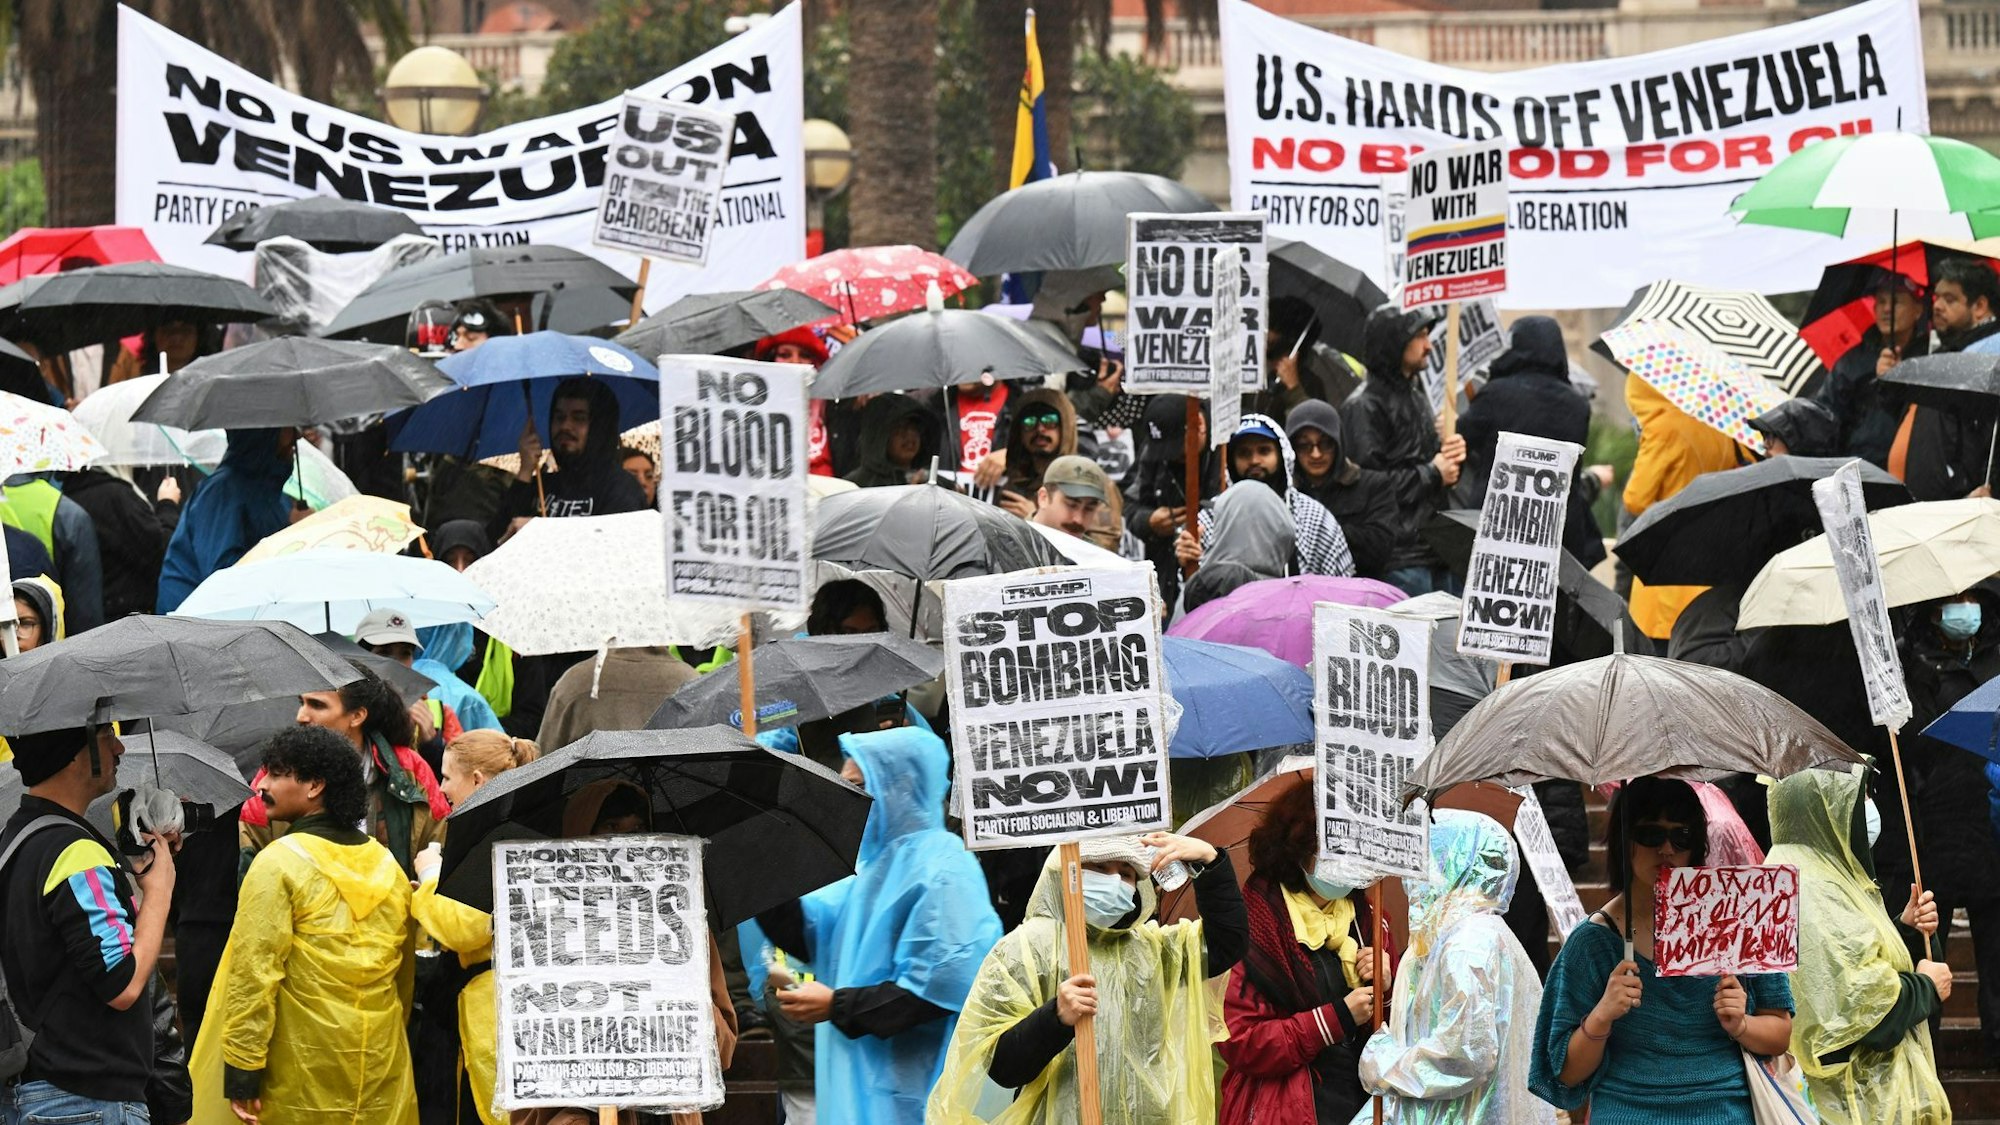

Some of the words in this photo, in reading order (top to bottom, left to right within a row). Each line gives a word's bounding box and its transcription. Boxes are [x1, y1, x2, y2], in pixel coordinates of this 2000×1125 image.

[1256, 54, 1336, 125] U.S.
[1346, 77, 1504, 141] HANDS
[1515, 90, 1601, 148] OFF
[1611, 34, 1888, 144] VENEZUELA
[166, 63, 275, 123] NO
[292, 112, 402, 164] US
[624, 105, 723, 155] US
[163, 111, 777, 211] VENEZUA
[616, 145, 718, 182] OUT
[1253, 137, 1346, 172] NO
[1359, 142, 1610, 180] BOD
[1625, 135, 1774, 177] FOR
[1411, 160, 1437, 199] NO
[1448, 149, 1502, 191] WAR
[154, 194, 219, 225] PARTY
[610, 173, 629, 197] OF
[682, 188, 712, 214] THE
[1309, 195, 1348, 227] FOR
[1432, 192, 1477, 221] WITH
[603, 199, 708, 242] CARIBBEAN
[1136, 246, 1185, 297] NO
[1406, 242, 1504, 283] VENEZUELA!
[1185, 327, 1207, 335] ON
[697, 369, 768, 406] NO
[674, 406, 793, 480] BLOOD
[1491, 461, 1570, 499] STOP
[672, 490, 739, 556] FOR
[747, 494, 799, 562] OIL
[956, 596, 1146, 647] STOP
[1468, 596, 1553, 632] NOW!
[1349, 617, 1400, 661] NO
[960, 633, 1150, 709] BOMBING
[1327, 656, 1419, 740] BLOOD
[965, 708, 1157, 772] VENEZUELA
[972, 760, 1159, 810] NOW!
[1325, 742, 1377, 818] FOR
[977, 818, 1010, 834] PARTY
[1011, 816, 1032, 832] FOR
[1032, 811, 1086, 830] SOCIALISM
[1087, 810, 1100, 825] &
[1101, 803, 1158, 824] LIBERATION
[1327, 820, 1349, 837] PARTY
[505, 848, 621, 864] MONEY
[627, 847, 690, 862] FOR
[1671, 871, 1712, 899] NO
[508, 883, 694, 968] NEEDS
[511, 980, 652, 1014] NOT
[512, 1017, 577, 1056] WAR
[581, 1015, 699, 1054] MACHINE
[572, 1061, 624, 1078] SOCIALISM
[626, 1062, 640, 1077] &
